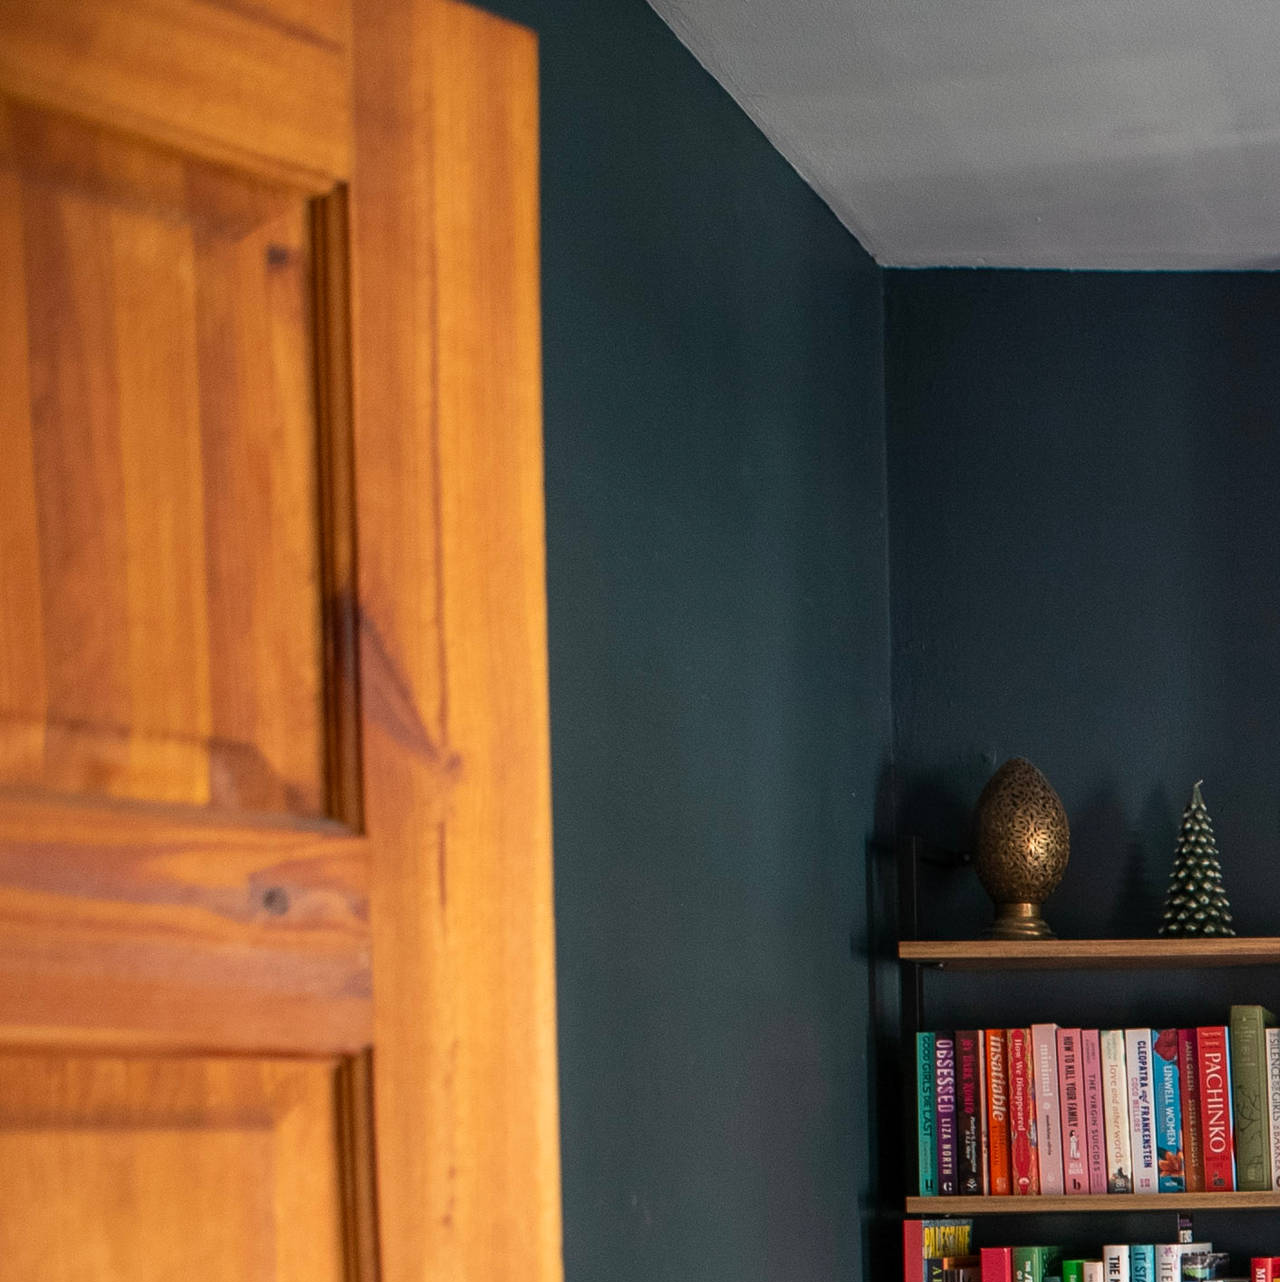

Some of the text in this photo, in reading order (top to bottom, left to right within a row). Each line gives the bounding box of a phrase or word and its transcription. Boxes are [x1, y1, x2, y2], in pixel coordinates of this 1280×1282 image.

[922, 1063, 932, 1093] GIRLS
[936, 1040, 954, 1113] OBSESSED
[990, 1036, 1006, 1121] insatiable
[1014, 1039, 1025, 1131] How We Disappeared
[1040, 1045, 1053, 1096] minimal
[1064, 1036, 1077, 1127] HOW KILL YOUR FAMILY
[1270, 1039, 1280, 1079] SILENCE
[923, 1109, 932, 1137] LAST
[1088, 1074, 1100, 1172] THE VIRGIN SUICIDES
[1109, 1064, 1119, 1086] love
[1114, 1129, 1123, 1163] words
[1137, 1041, 1152, 1168] CLEOPATRA FRANKENSTEIN
[1164, 1065, 1176, 1145] UNWELL WOMEN
[1205, 1053, 1226, 1153] PACHINKO
[942, 1118, 953, 1175] LIZA NORTH
[1191, 1128, 1199, 1167] STARDUST
[933, 1266, 942, 1275] A
[1109, 1255, 1120, 1275] THE
[1135, 1252, 1146, 1262] IT
[1161, 1263, 1173, 1272] IT
